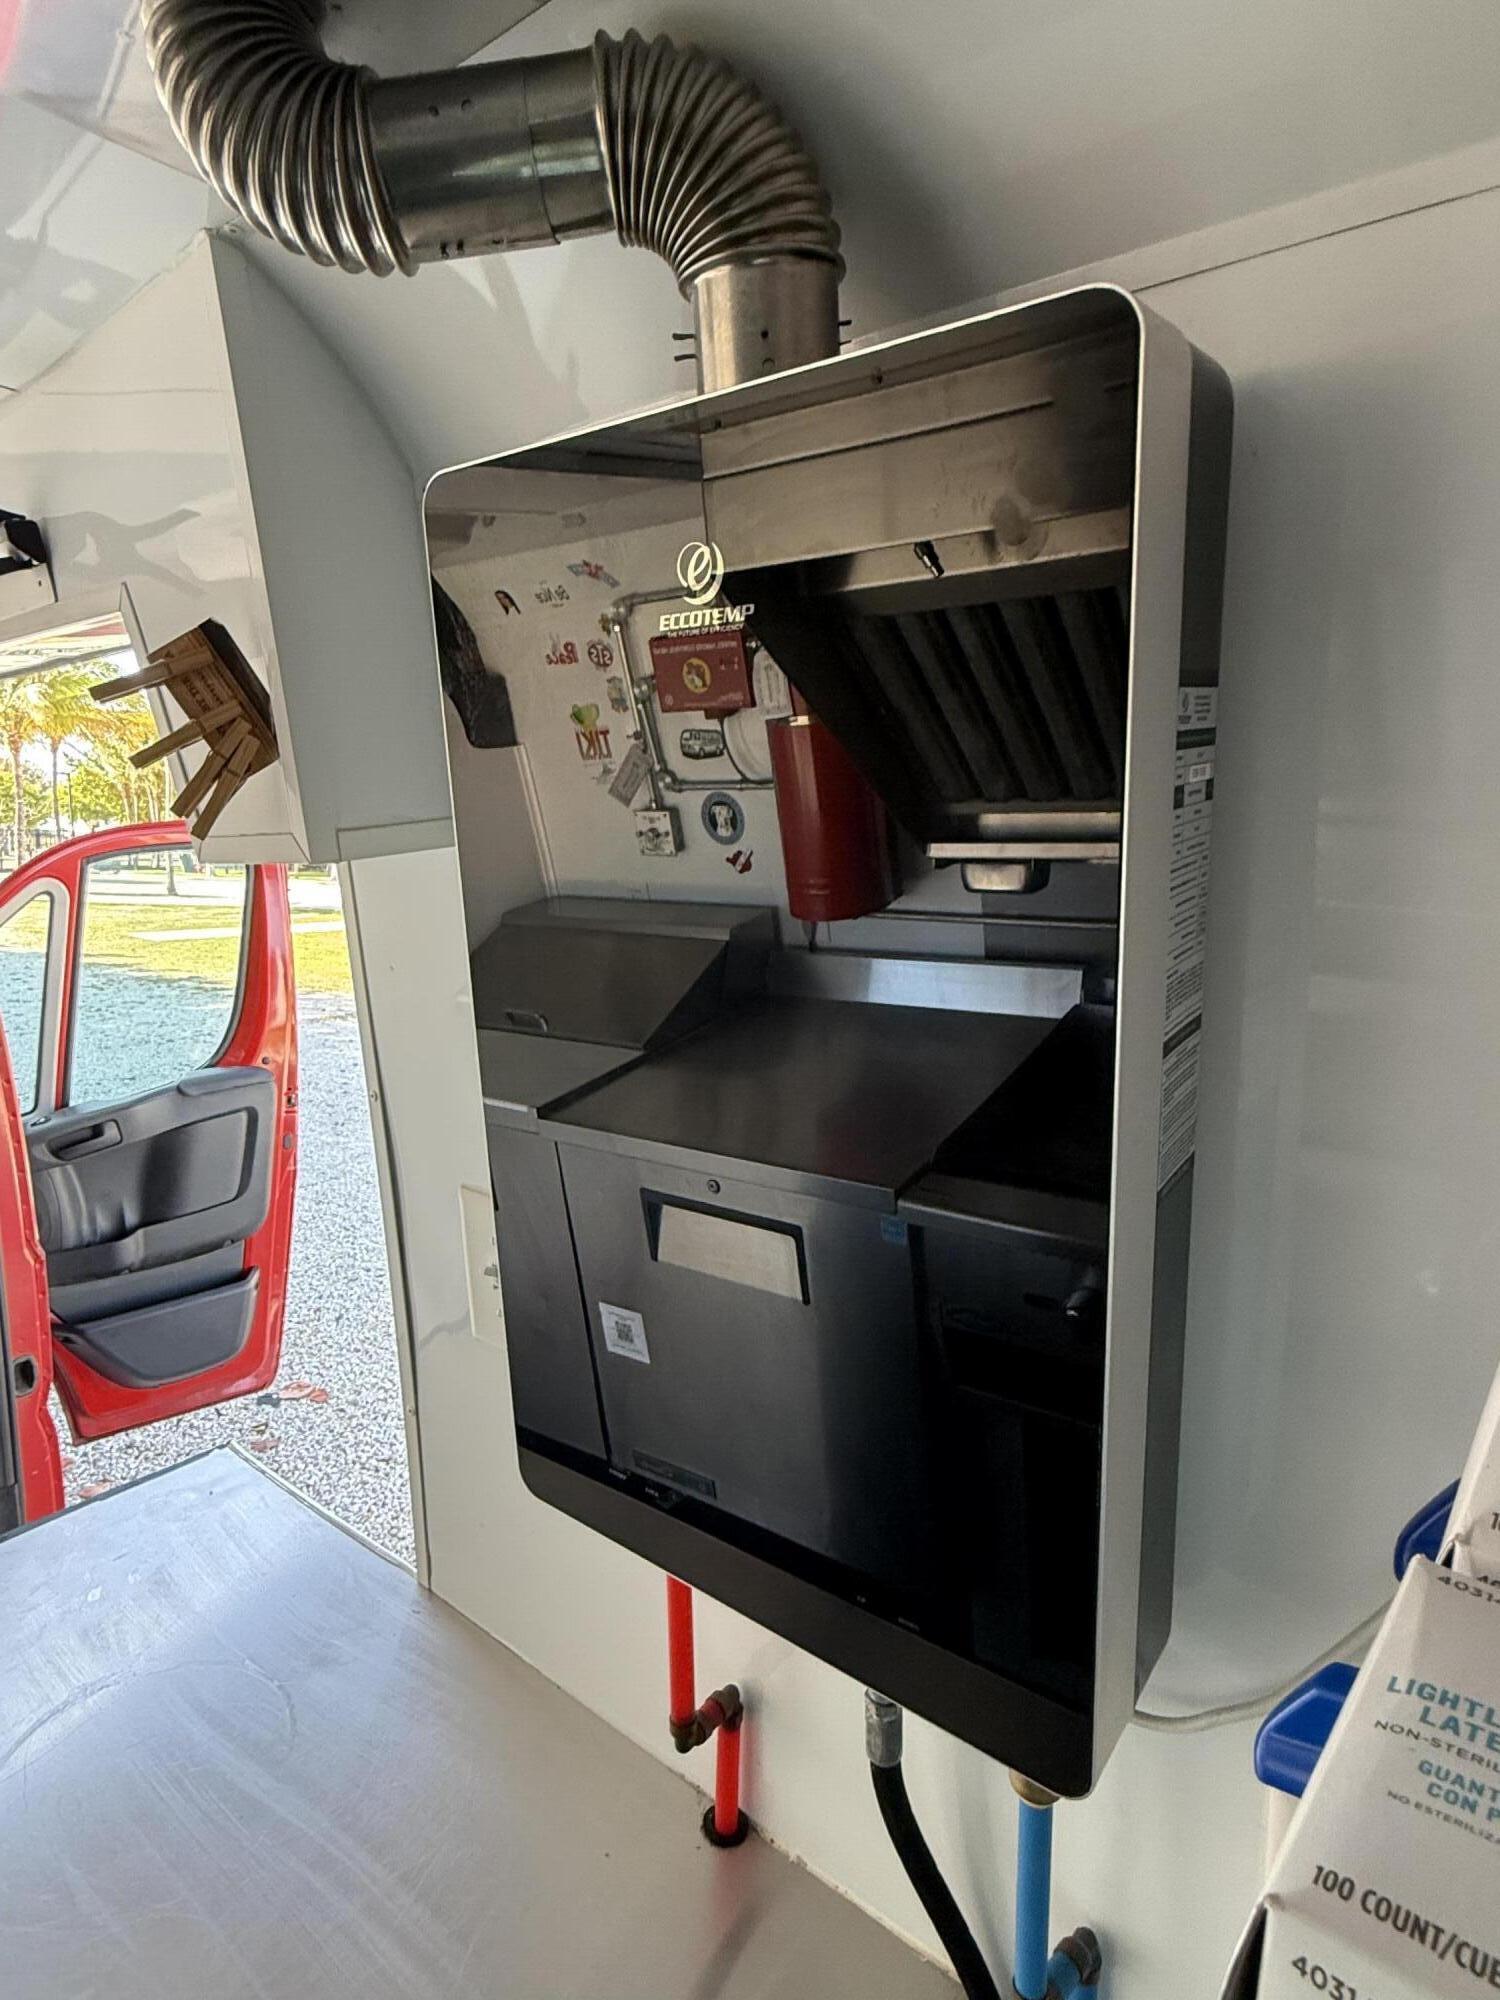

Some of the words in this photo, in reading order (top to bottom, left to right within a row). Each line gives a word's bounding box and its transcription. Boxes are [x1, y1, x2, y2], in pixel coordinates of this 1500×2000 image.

[659, 603, 755, 632] ECCOTEMP
[1387, 1676, 1500, 1729] LIGHTL
[1374, 1720, 1500, 1774] NON-STERIL
[1419, 1705, 1500, 1750] LATE
[1387, 1790, 1410, 1805] NO
[1418, 1759, 1500, 1801] GUANT
[1426, 1782, 1478, 1814] CON
[1312, 1865, 1356, 1902] 100
